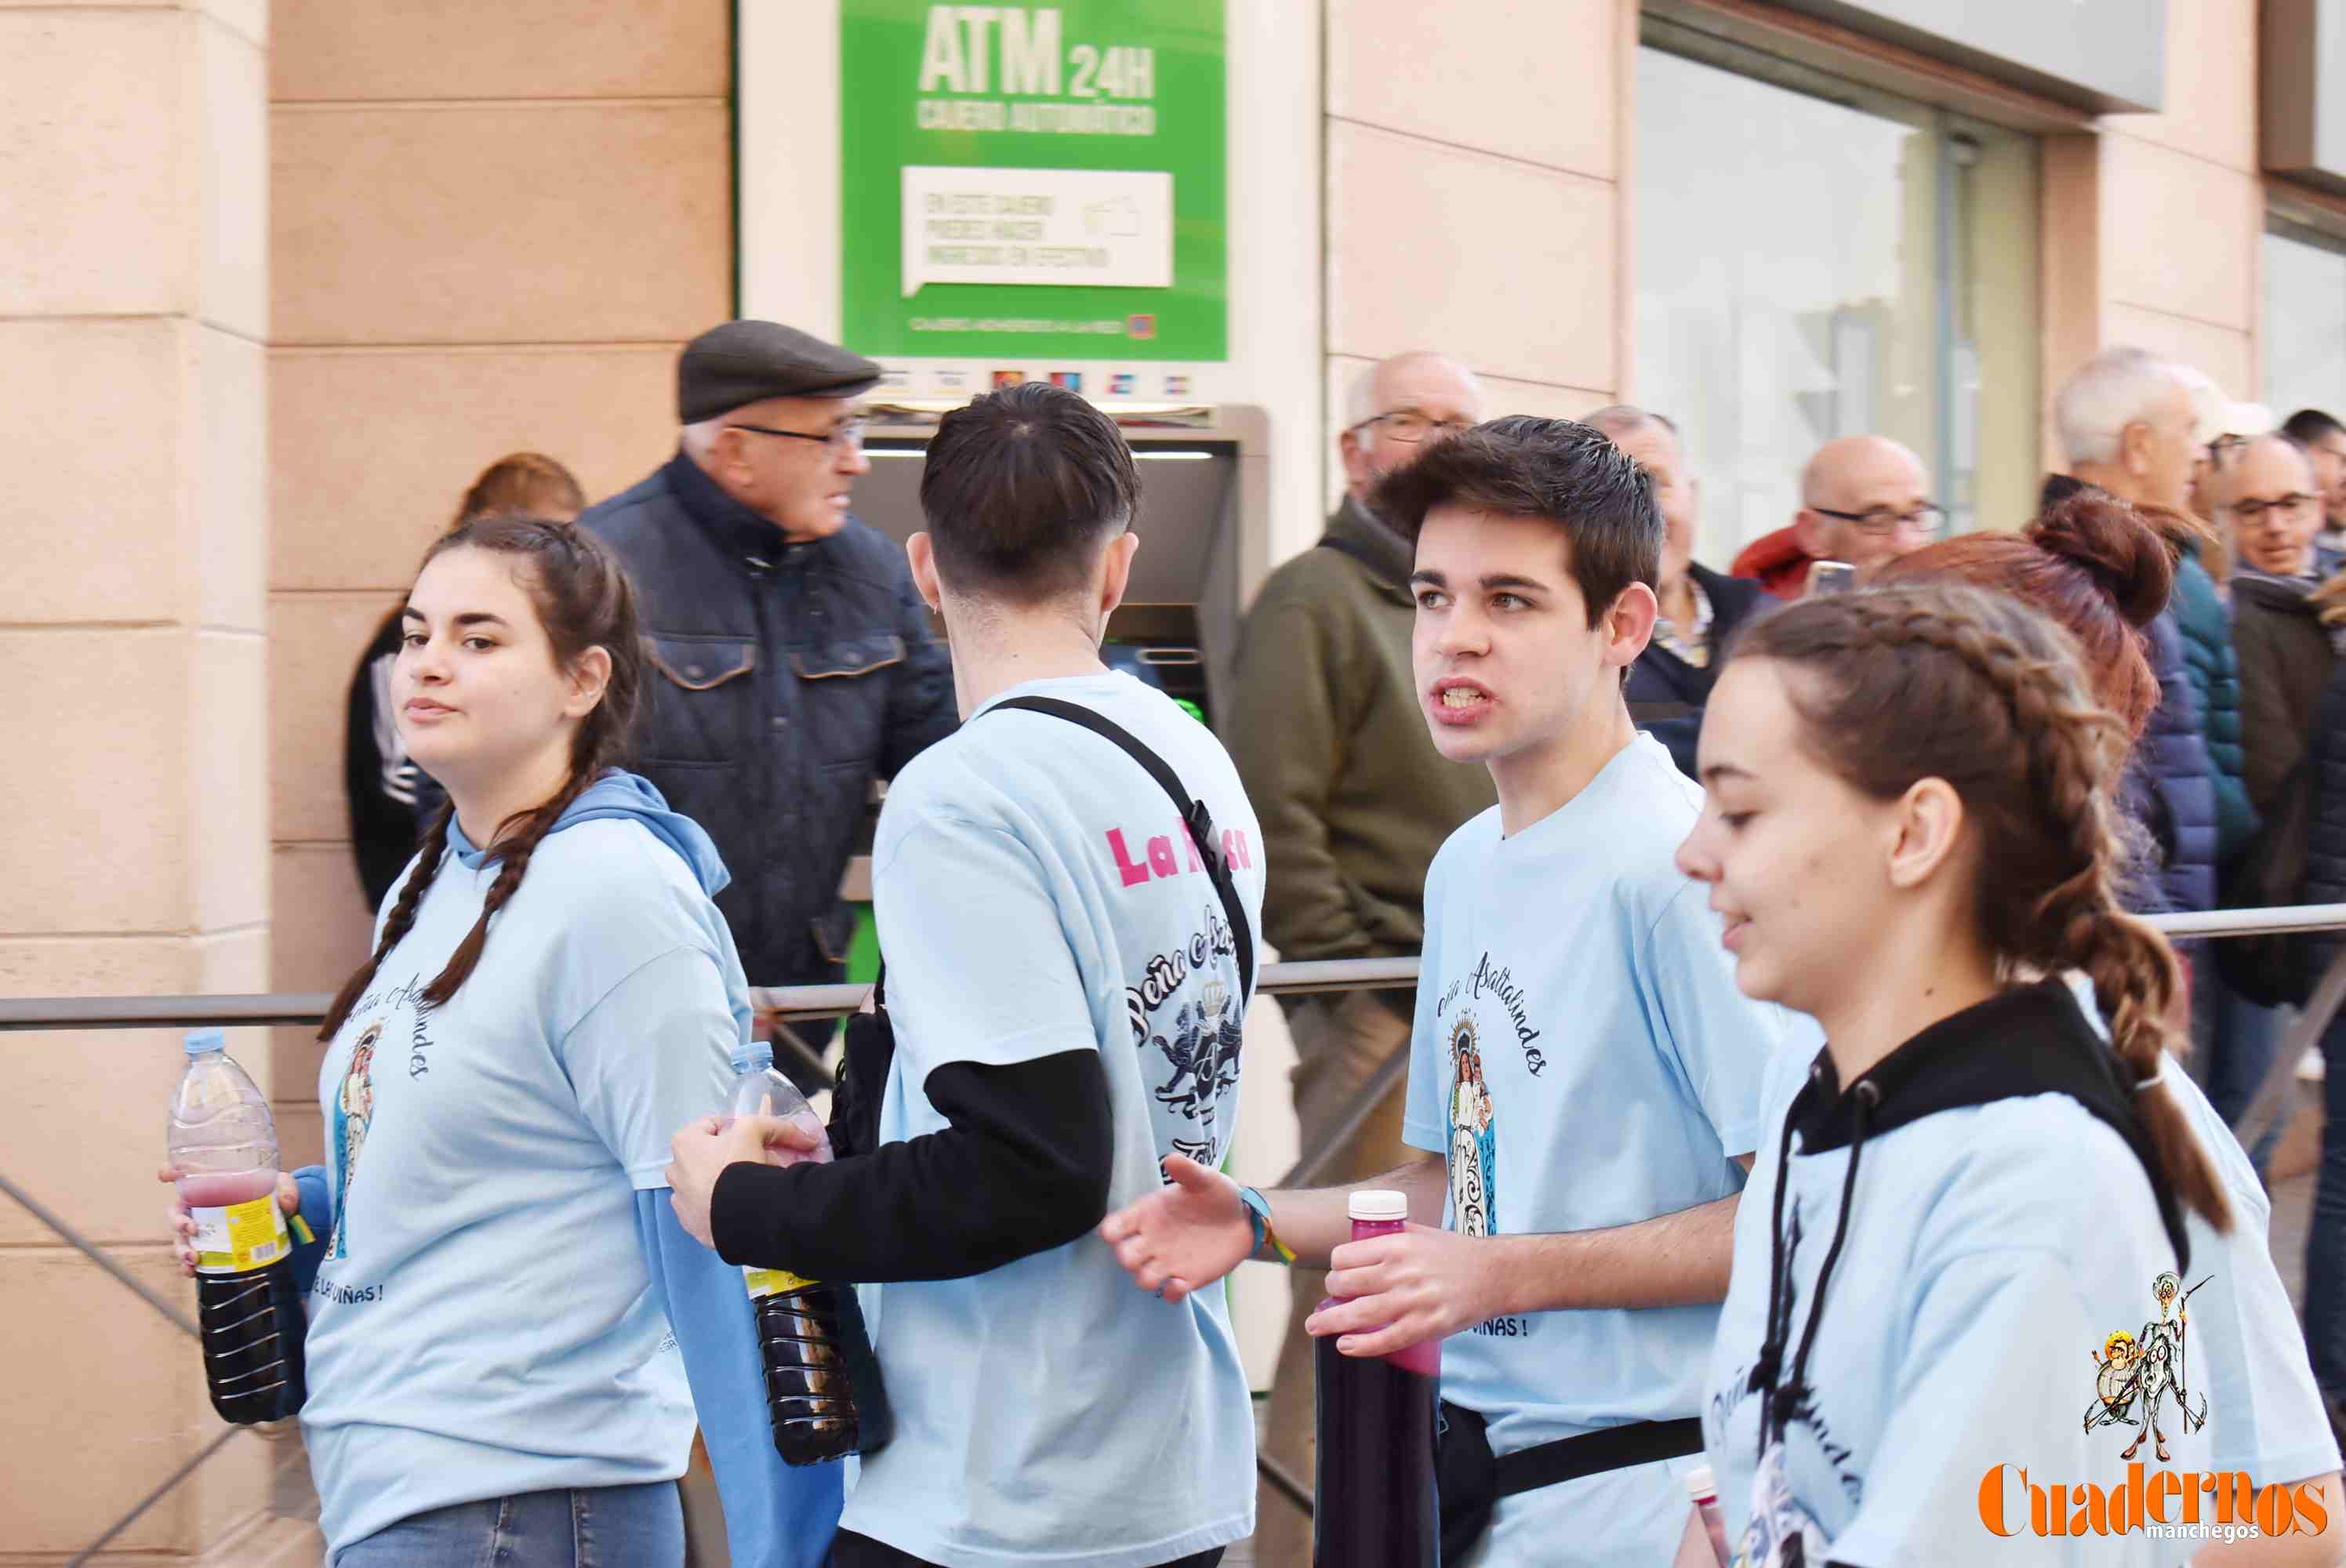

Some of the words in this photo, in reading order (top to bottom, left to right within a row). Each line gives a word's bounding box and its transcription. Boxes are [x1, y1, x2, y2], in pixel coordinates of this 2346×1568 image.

[918, 5, 1061, 95] ATM
[1069, 44, 1155, 100] 24H
[916, 100, 1005, 131] CAJERO
[1105, 827, 1178, 887] La
